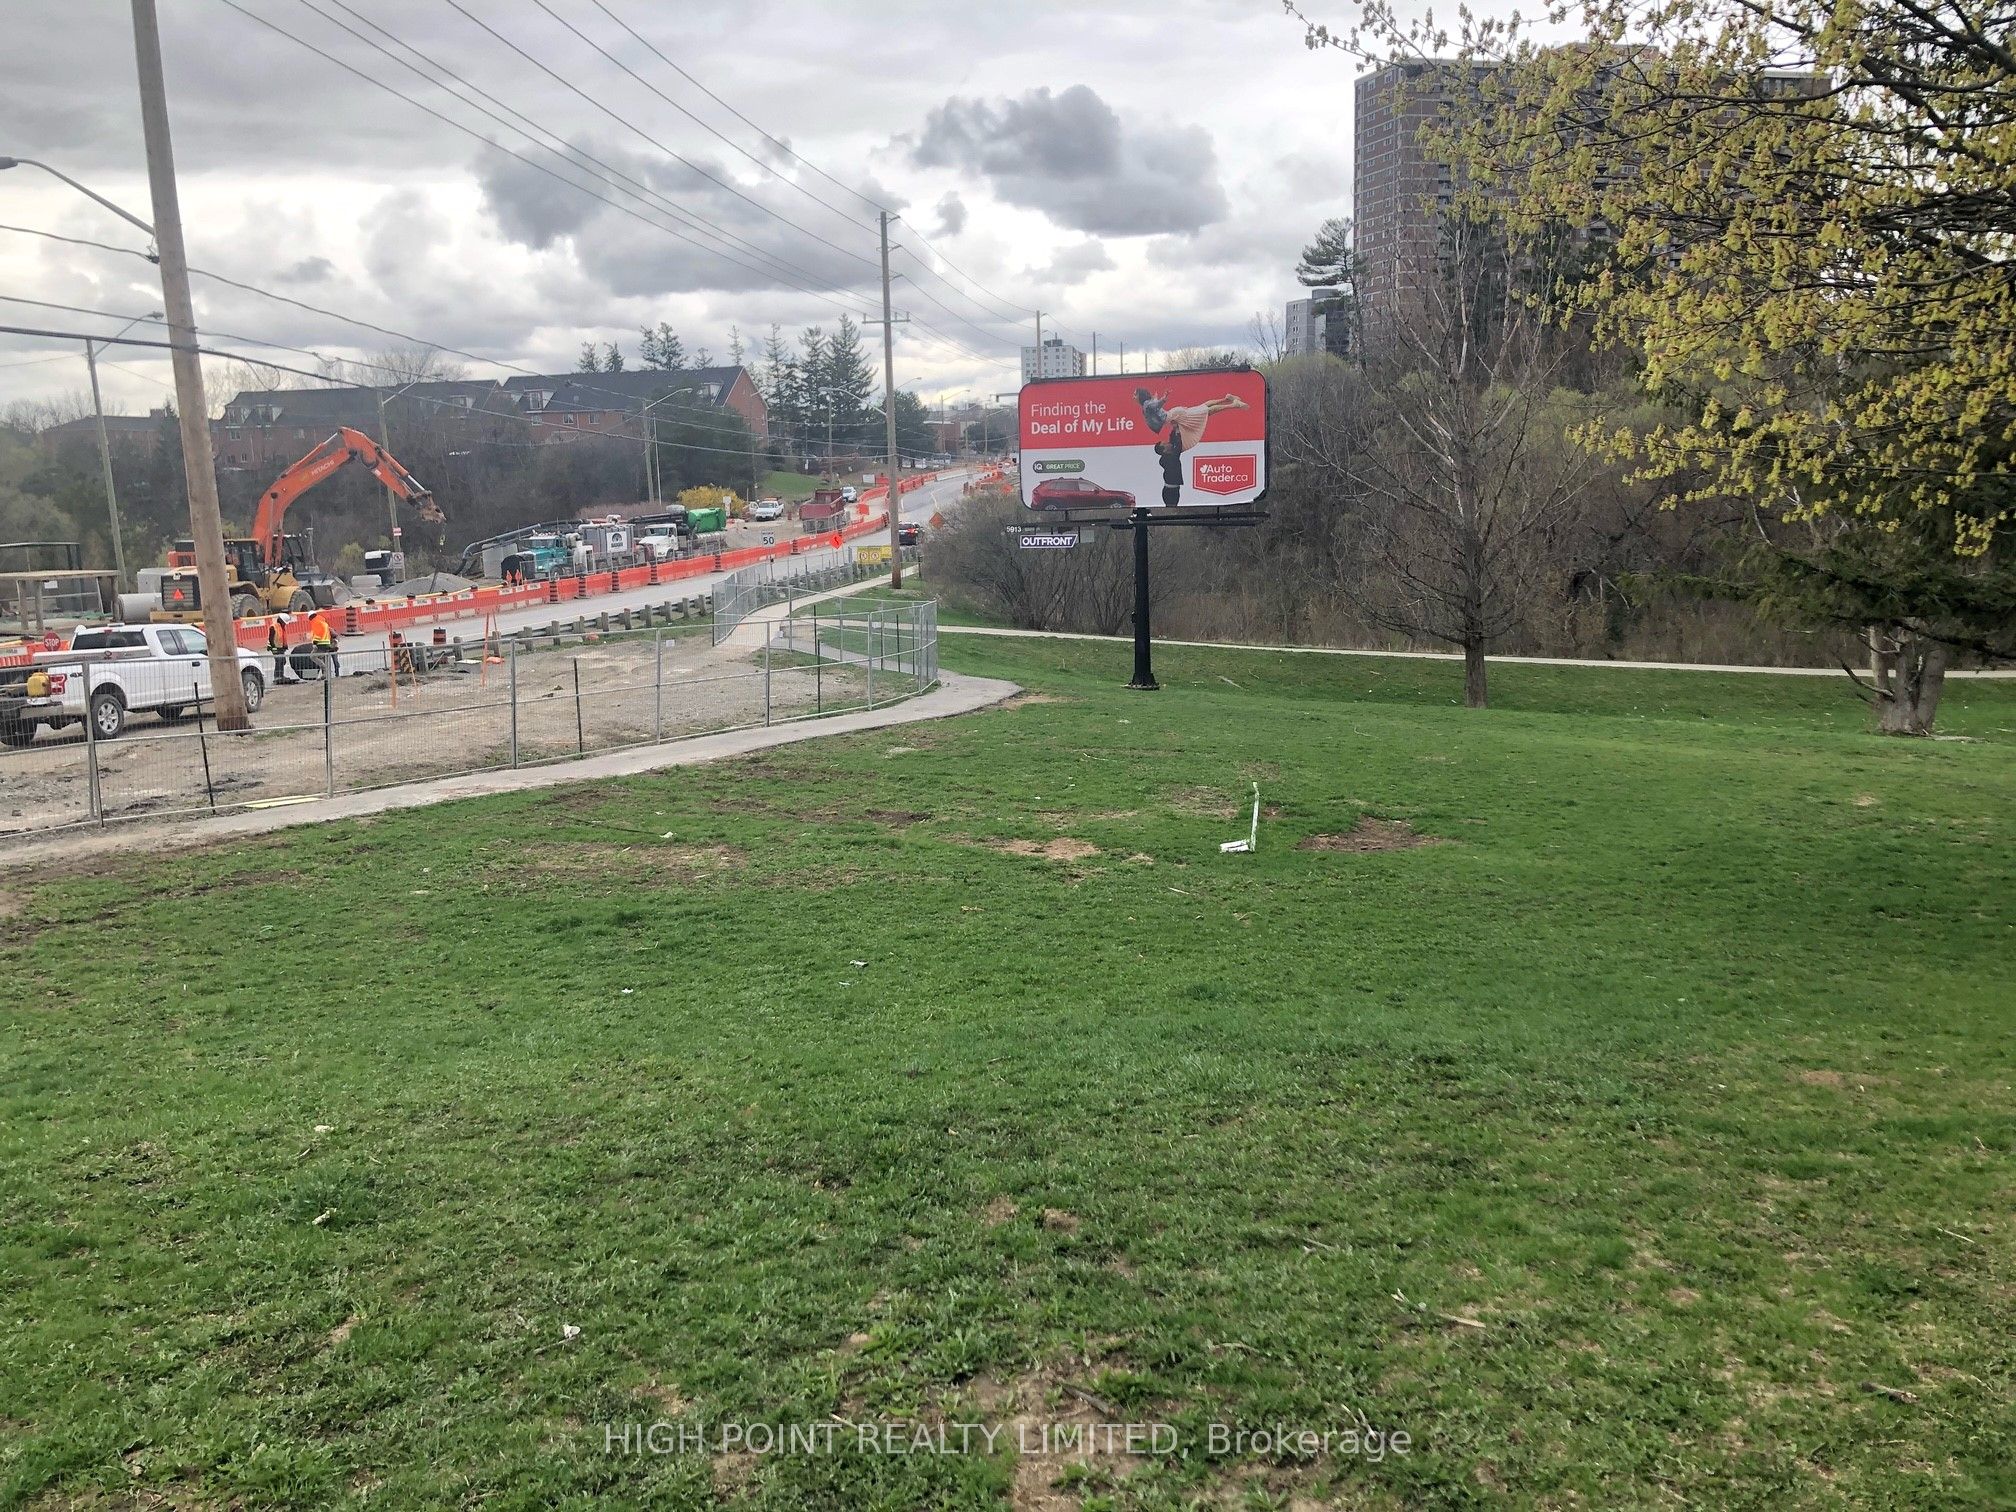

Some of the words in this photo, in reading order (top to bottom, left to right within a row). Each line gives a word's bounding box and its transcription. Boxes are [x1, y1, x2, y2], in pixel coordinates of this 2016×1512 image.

[1031, 402, 1080, 418] Finding
[1084, 401, 1106, 414] the
[1031, 420, 1061, 434] Deal
[1064, 420, 1079, 433] of
[1082, 419, 1103, 435] My
[1107, 417, 1134, 431] Life
[311, 459, 335, 476] HITACHI
[1207, 464, 1232, 473] Auto
[1202, 473, 1248, 483] Trader.ca
[763, 536, 775, 545] 50
[1022, 537, 1072, 546] OUTFRONT
[44, 638, 60, 646] STOP
